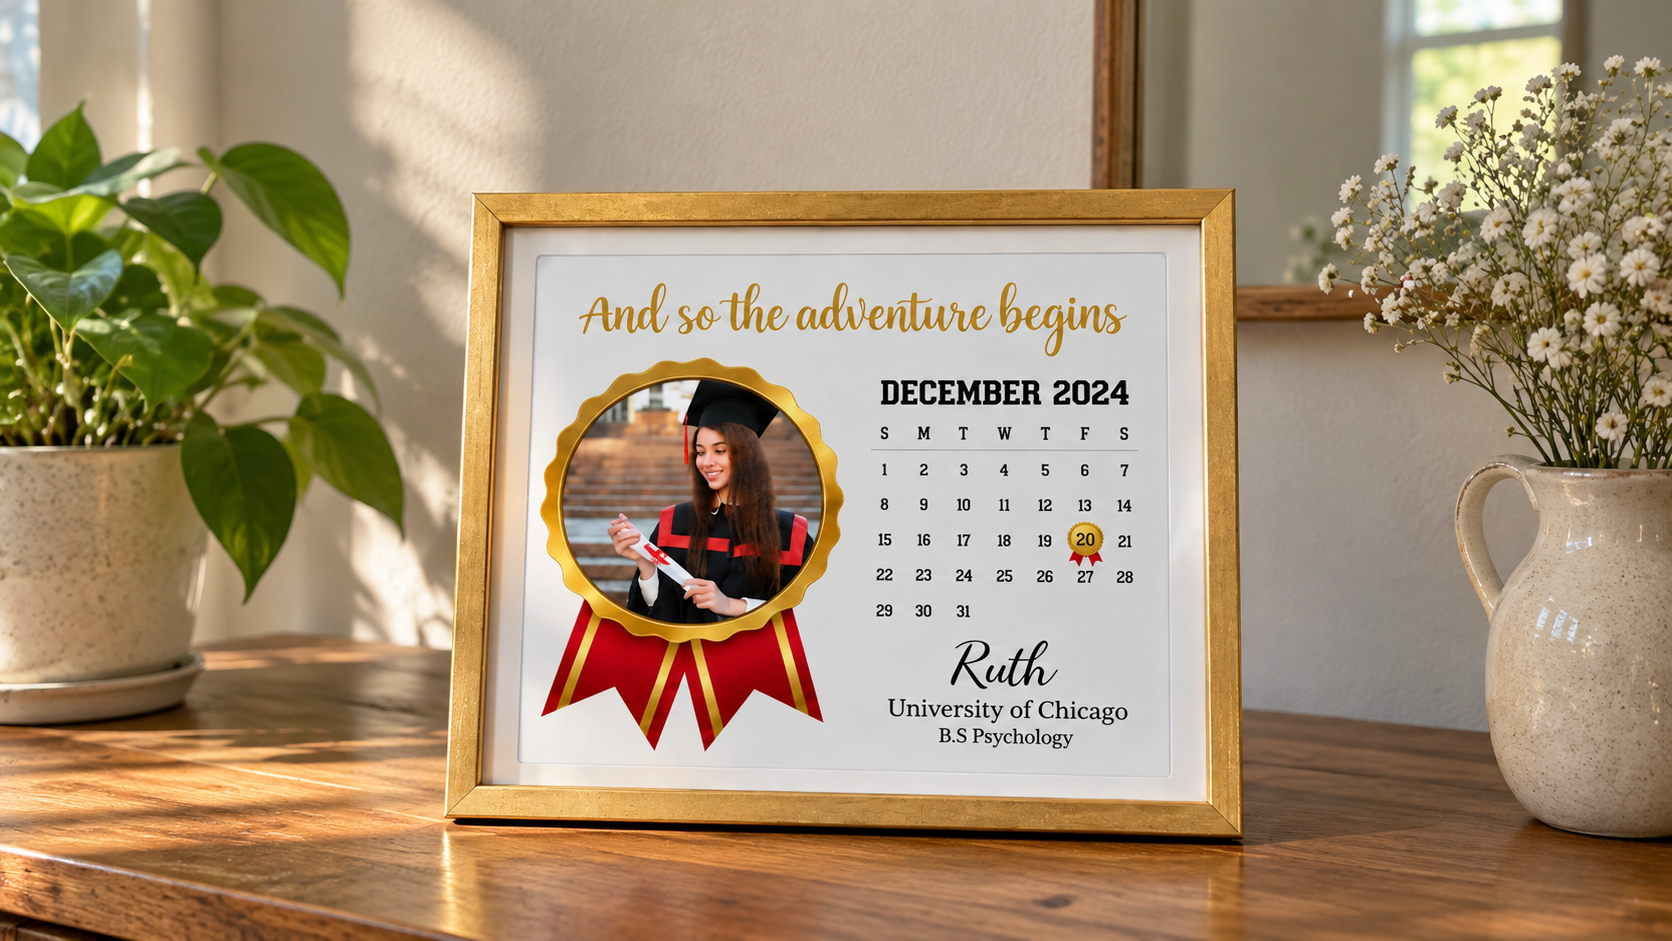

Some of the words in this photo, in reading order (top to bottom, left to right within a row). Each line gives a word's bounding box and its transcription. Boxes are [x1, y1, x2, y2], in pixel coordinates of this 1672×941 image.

[579, 283, 669, 334] And
[678, 300, 721, 335] so
[719, 283, 790, 333] the
[796, 283, 993, 333] adventure
[999, 282, 1127, 357] begins
[880, 380, 1042, 405] DECEMBER
[1053, 380, 1129, 405] 2024
[880, 427, 889, 440] S
[917, 426, 931, 440] M
[958, 426, 969, 440] T
[997, 426, 1012, 440] W
[1040, 427, 1051, 440] T
[1080, 427, 1090, 440] F
[1119, 427, 1129, 441] S
[881, 463, 888, 476] 1
[919, 463, 929, 476] 2
[959, 463, 969, 476] 3
[999, 463, 1009, 477] 4
[1041, 463, 1050, 477] 5
[1080, 463, 1090, 477] 6
[1120, 464, 1130, 477] 7
[880, 498, 889, 511] 8
[919, 498, 929, 511] 9
[957, 498, 971, 511] 10
[998, 498, 1011, 511] 11
[1037, 498, 1052, 512] 12
[1078, 499, 1092, 512] 13
[1117, 499, 1132, 512] 14
[878, 533, 892, 546] 15
[917, 534, 931, 547] 16
[957, 534, 971, 547] 17
[997, 534, 1011, 547] 18
[1038, 534, 1052, 548] 19
[1076, 532, 1095, 547] 20
[1118, 534, 1132, 549] 21
[876, 568, 893, 582] 22
[915, 568, 932, 582] 23
[955, 569, 973, 582] 24
[996, 570, 1013, 583] 25
[1037, 570, 1054, 583] 26
[1077, 570, 1094, 584] 27
[1116, 571, 1134, 584] 28
[876, 604, 893, 617] 29
[915, 604, 932, 618] 30
[956, 605, 971, 618] 31
[950, 639, 1058, 689] Ruth
[888, 698, 1004, 723] University
[1009, 699, 1034, 719] of
[1038, 700, 1128, 725] Chicago
[939, 728, 967, 743] B.S
[972, 728, 1074, 749] Psychology
